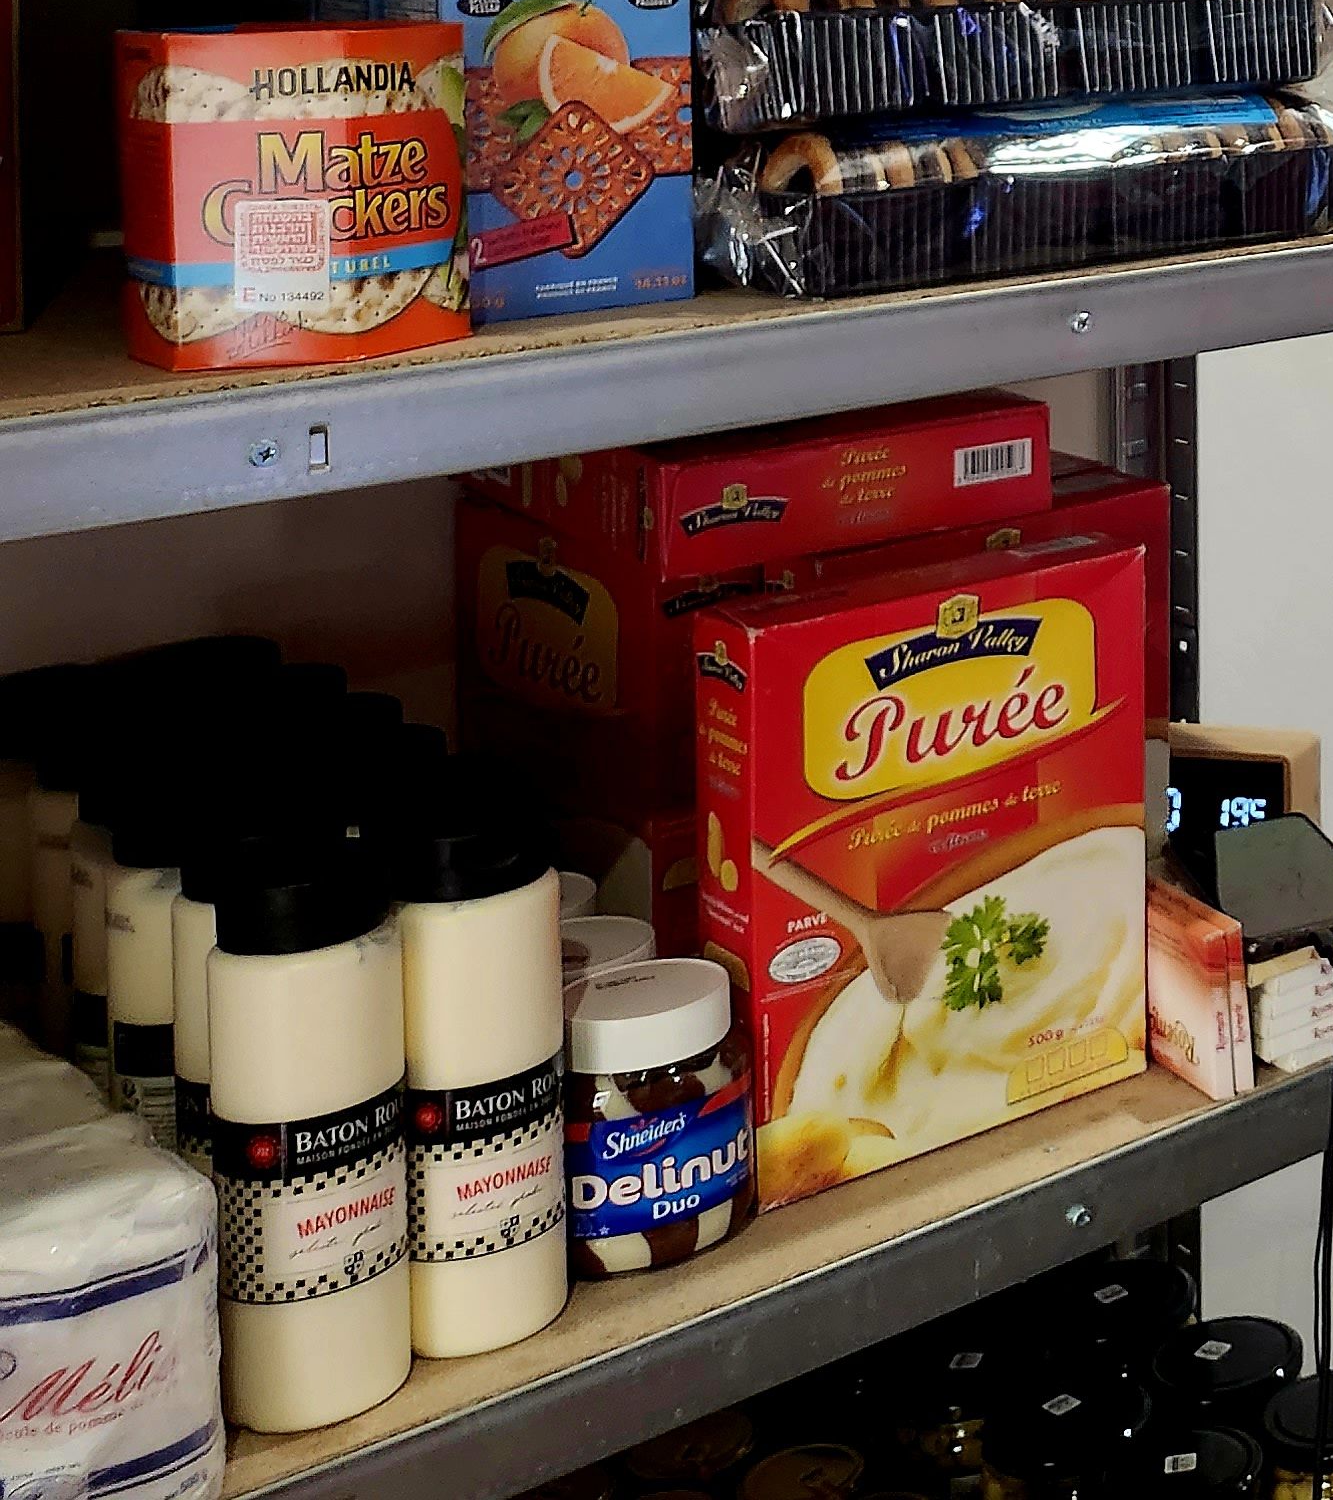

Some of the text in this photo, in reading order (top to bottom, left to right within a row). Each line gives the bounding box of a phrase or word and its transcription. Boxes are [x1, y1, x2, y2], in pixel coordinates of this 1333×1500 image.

[250, 61, 416, 100] HOLLANDIA
[257, 130, 428, 194] Matze
[202, 180, 450, 246] Cckers
[332, 255, 391, 275] TUREL
[280, 290, 325, 302] 134492
[880, 624, 1030, 679] Sharon Valley
[835, 665, 1069, 781] Purée
[848, 819, 901, 850] Purée
[926, 797, 999, 833] pommes
[1022, 780, 1062, 803] terre
[455, 1087, 525, 1120] BATON
[456, 1118, 493, 1131] MAISON
[295, 1116, 368, 1153] BATON
[296, 1150, 335, 1165] MAISON
[602, 1112, 687, 1160] Shneider's
[456, 1155, 553, 1202] MAYONNAISE
[572, 1128, 749, 1210] Delinut
[296, 1186, 396, 1238] MAYONNAISE
[652, 1194, 701, 1220] Duo
